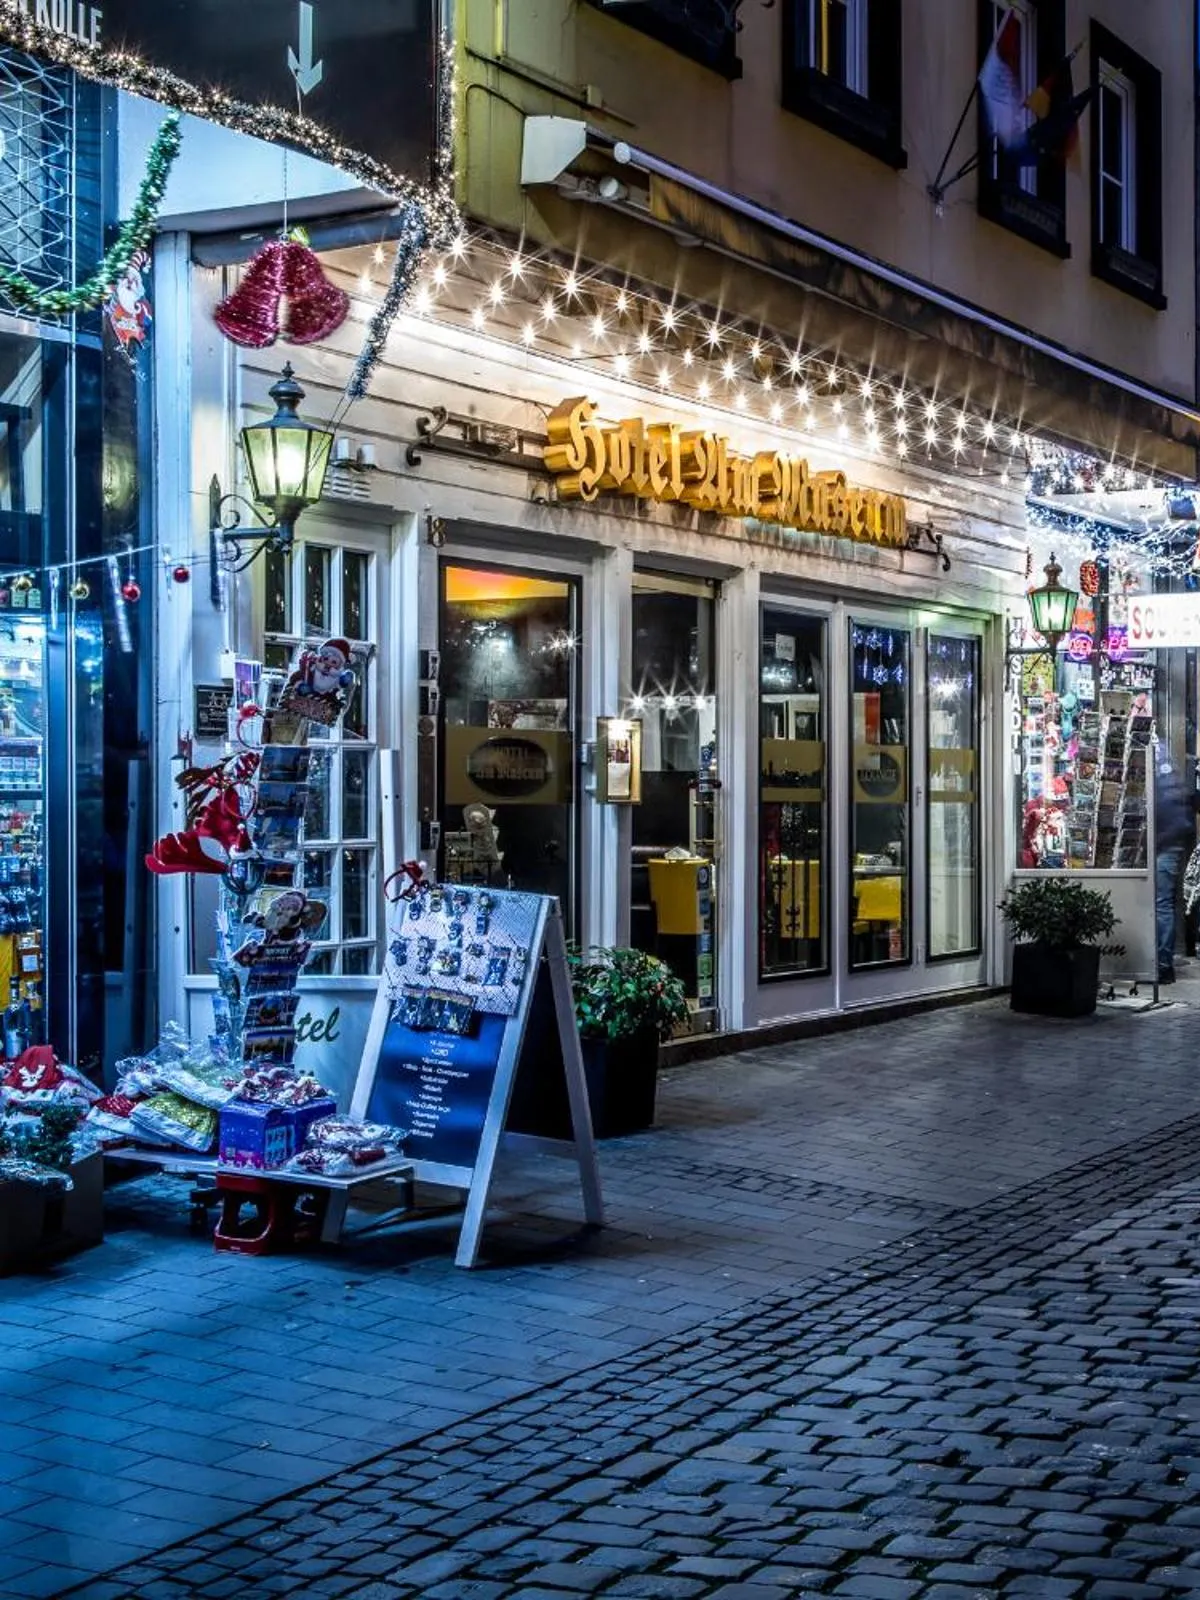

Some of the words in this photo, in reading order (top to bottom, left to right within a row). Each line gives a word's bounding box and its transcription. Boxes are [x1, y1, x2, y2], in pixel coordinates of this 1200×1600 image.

[544, 396, 686, 501] Hotel
[427, 515, 447, 548] 18
[297, 1008, 340, 1042] tel
